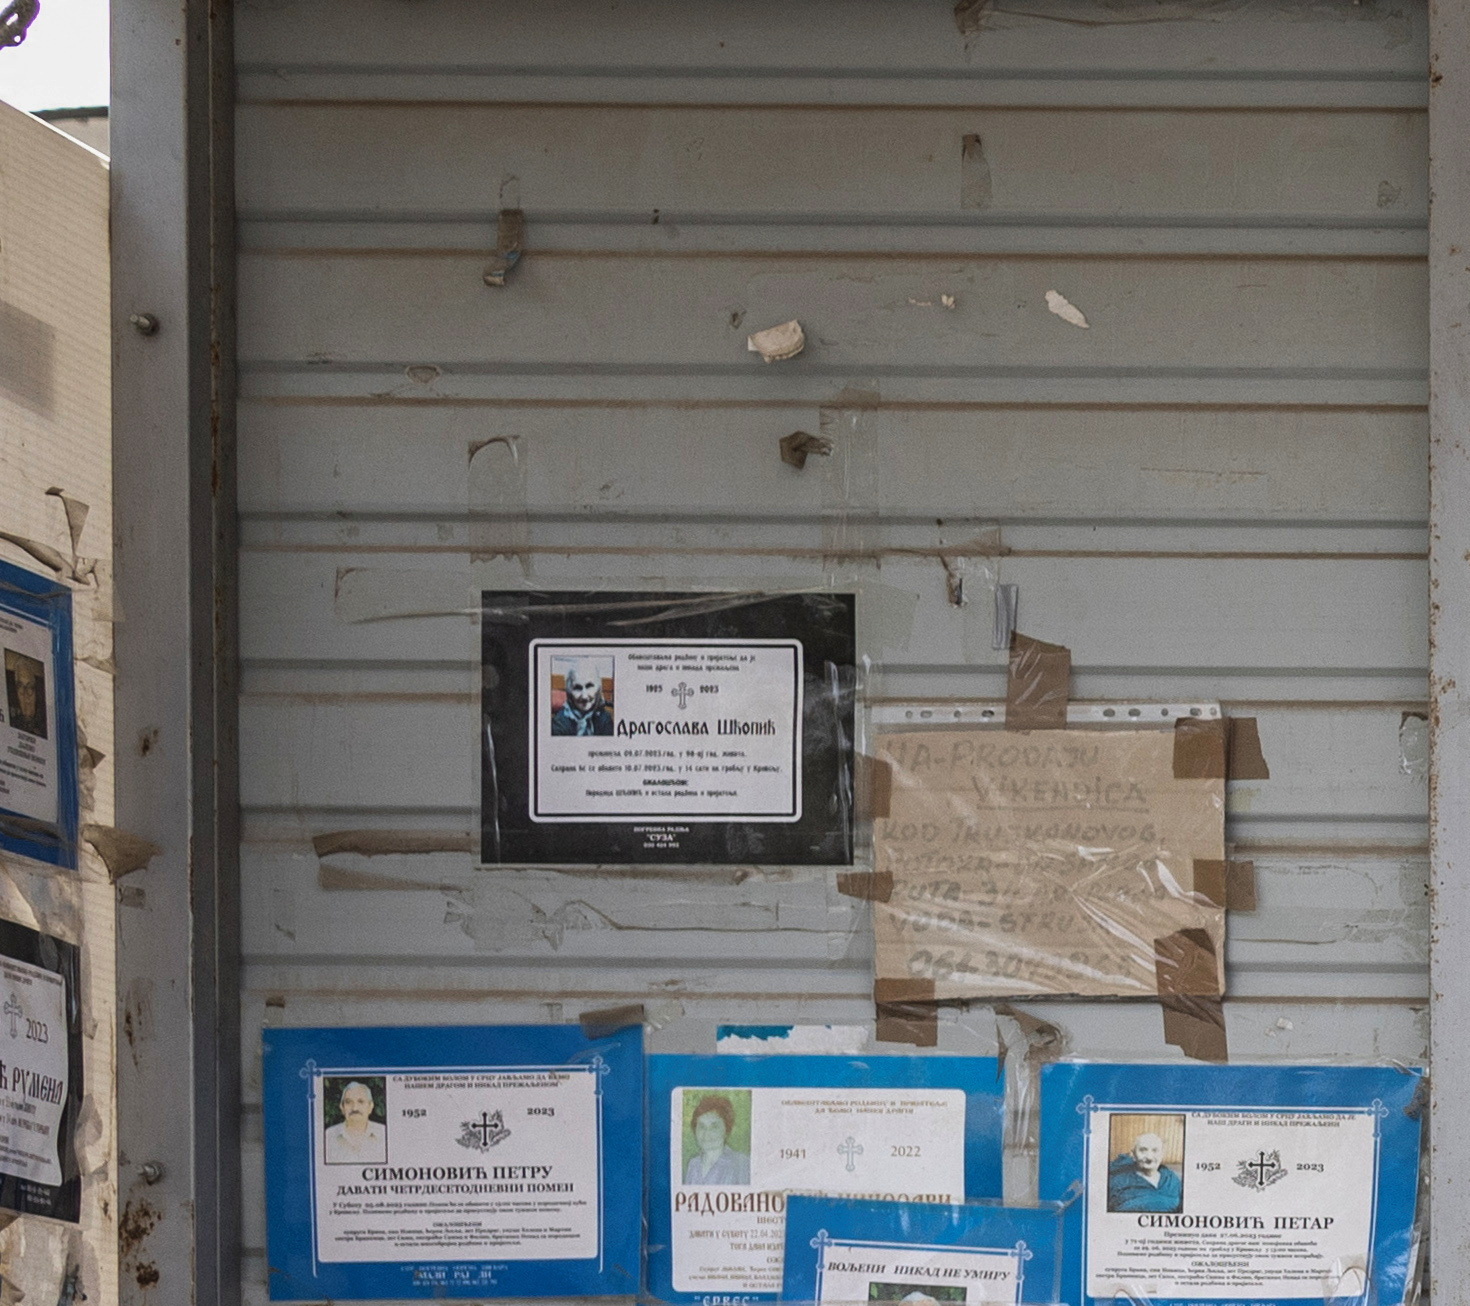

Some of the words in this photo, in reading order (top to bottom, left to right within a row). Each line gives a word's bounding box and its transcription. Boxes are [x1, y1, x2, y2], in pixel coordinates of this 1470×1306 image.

[617, 720, 709, 738] Драгослава
[362, 1167, 487, 1181] СИМОНОВИЋ
[493, 1166, 552, 1179] ПЕТРУ
[1138, 1215, 1264, 1229] СИМОНОВИЋ
[1274, 1216, 1334, 1229] ПЕТАР
